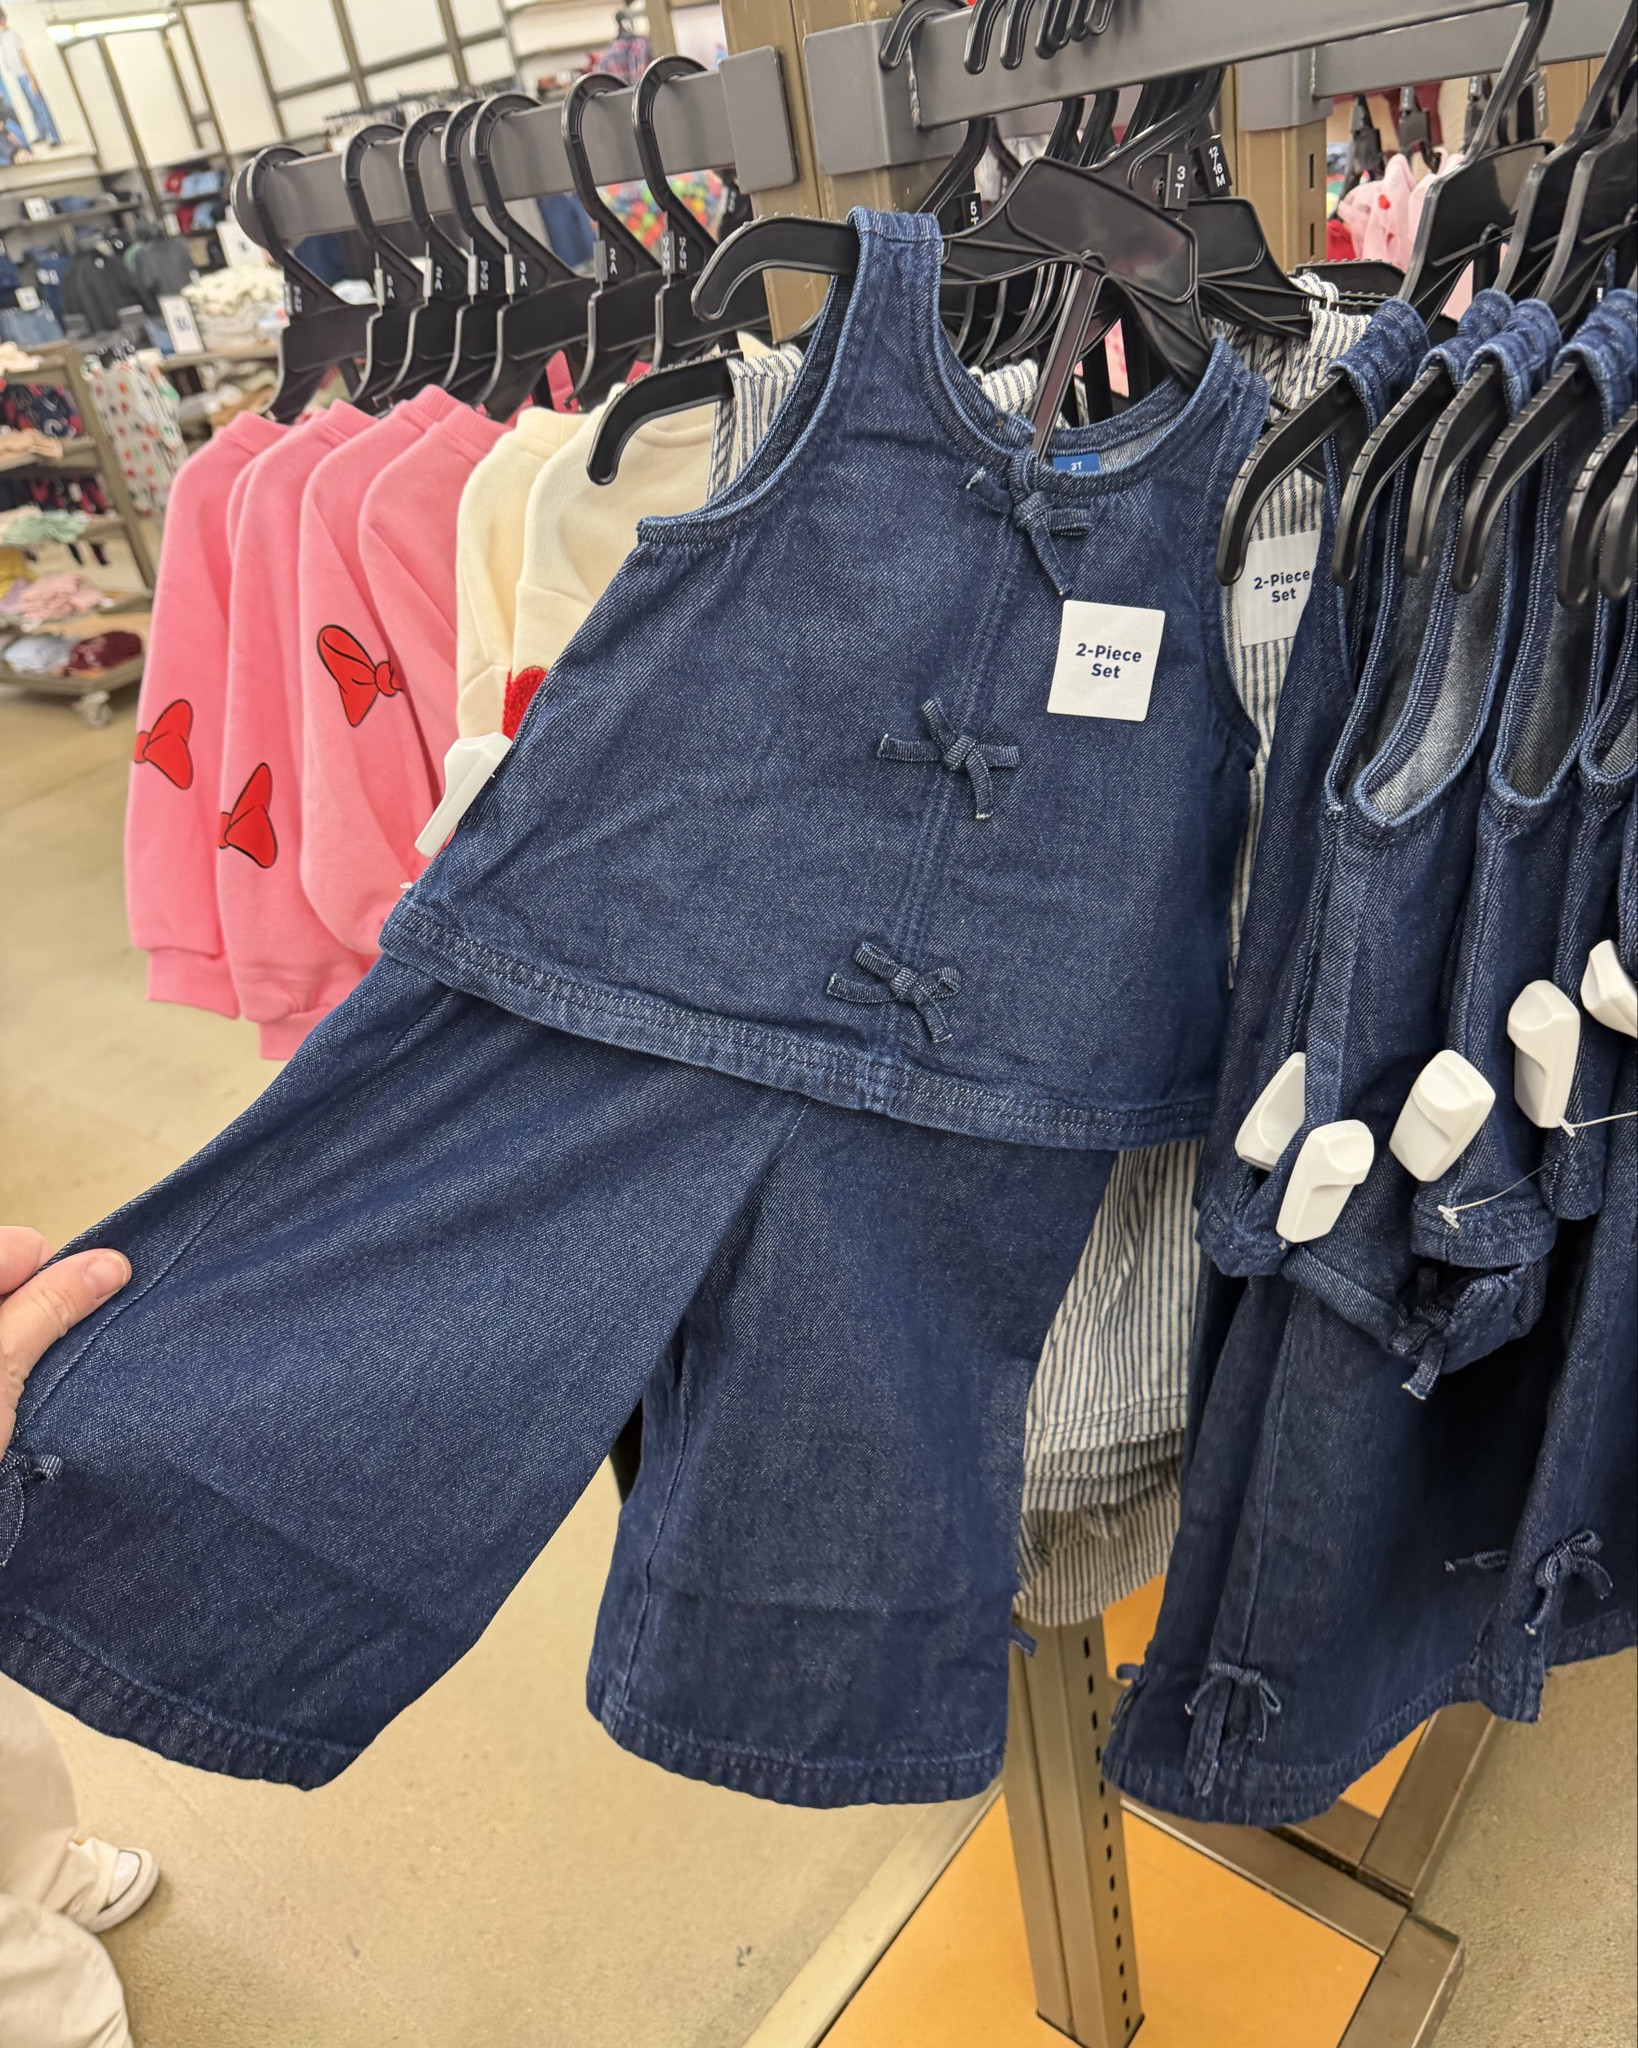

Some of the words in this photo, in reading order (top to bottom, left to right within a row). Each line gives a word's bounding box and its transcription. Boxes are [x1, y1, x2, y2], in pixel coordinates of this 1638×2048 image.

[1070, 461, 1083, 471] 3T
[1254, 568, 1311, 590] 2-Piece
[1271, 588, 1297, 603] Set
[1076, 642, 1142, 663] 2-Piece
[1091, 663, 1121, 679] Set
